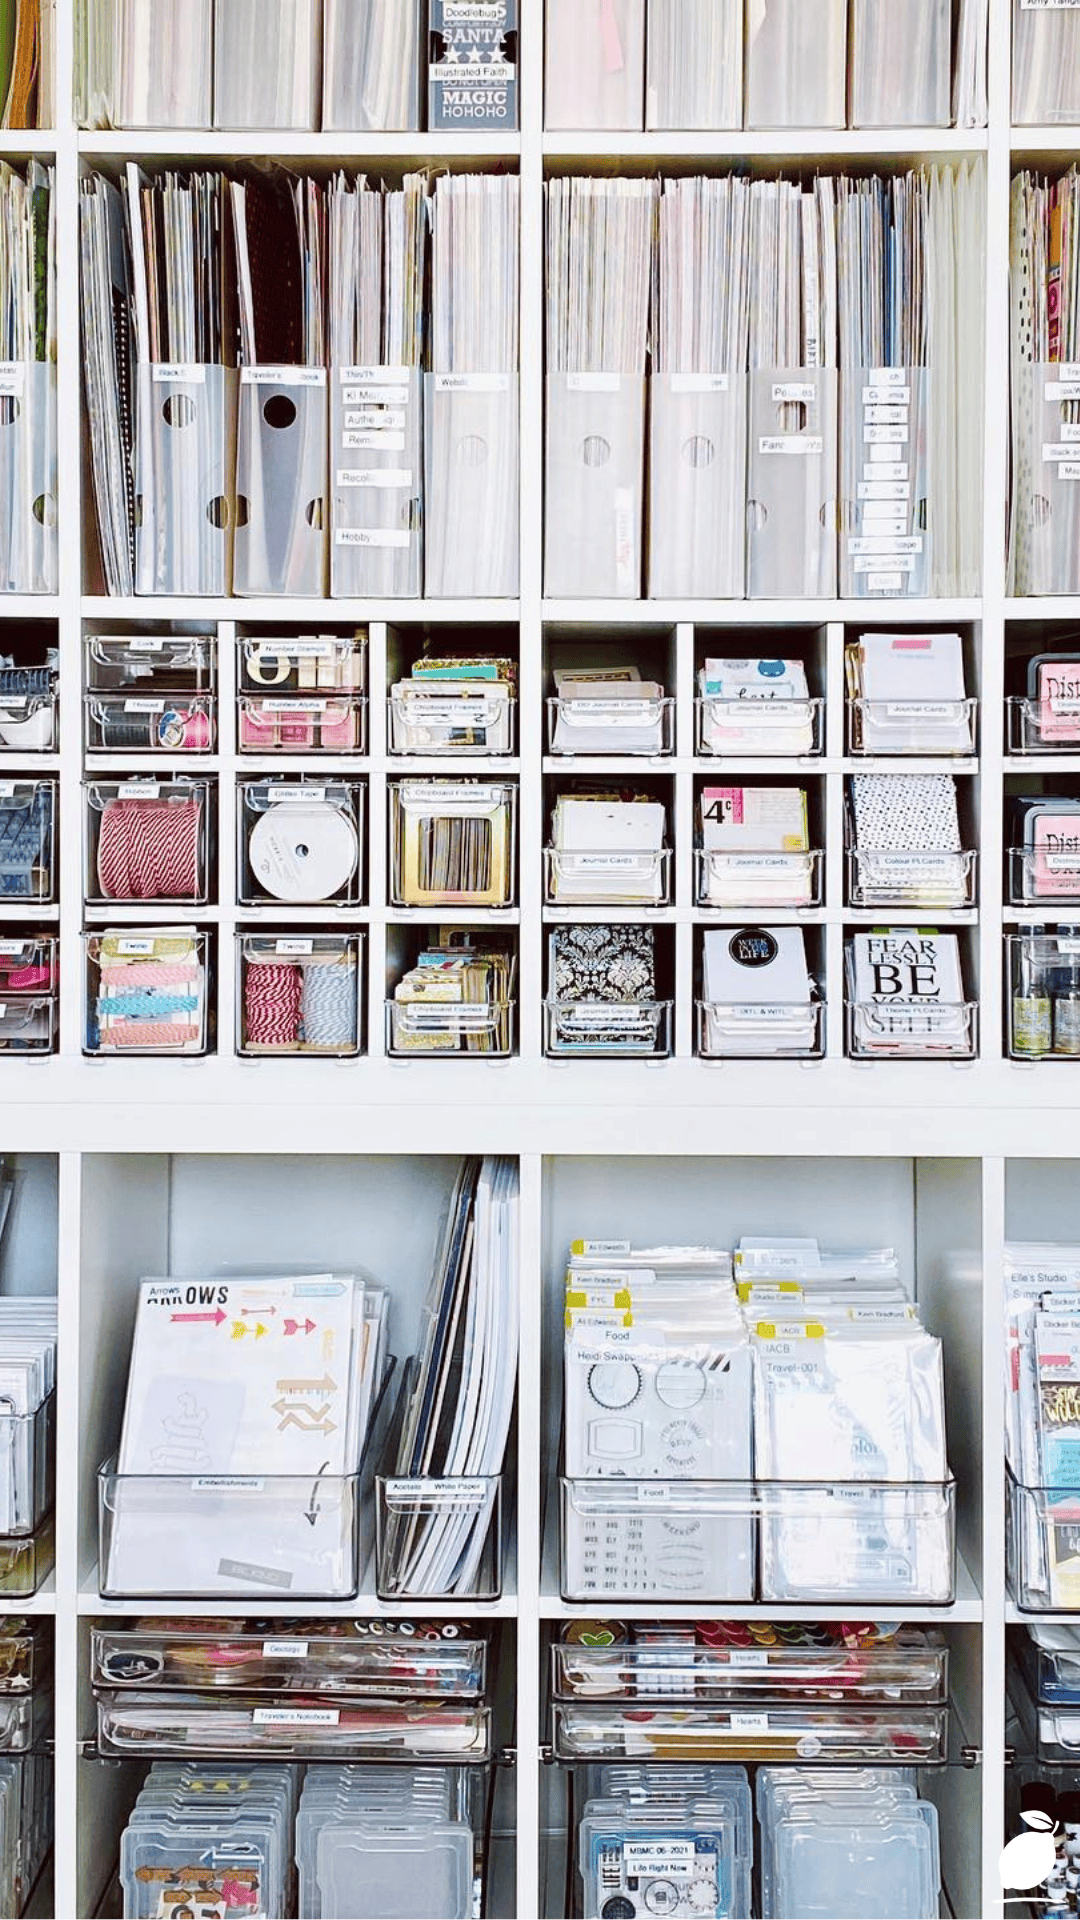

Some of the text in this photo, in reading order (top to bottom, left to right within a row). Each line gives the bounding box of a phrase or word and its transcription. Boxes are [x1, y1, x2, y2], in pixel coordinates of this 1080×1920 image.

[445, 8, 497, 18] Doodlebug
[442, 28, 507, 43] SANTA
[442, 91, 507, 105] MAGIC
[442, 106, 507, 118] HOHOHO
[866, 939, 936, 953] FEAR
[868, 952, 937, 964] LESSLY
[869, 964, 941, 996] BE
[1011, 1272, 1067, 1282] Elle's Studio
[150, 1286, 181, 1295] Arrows
[605, 1331, 630, 1341] Food
[766, 1343, 790, 1354] IACB
[766, 1362, 818, 1373] Travel-001
[434, 1482, 481, 1491] White Paper
[643, 1487, 665, 1496] Food
[735, 1654, 761, 1663] Hearts
[736, 1716, 762, 1725] Hearts
[670, 1863, 688, 1872] Now
